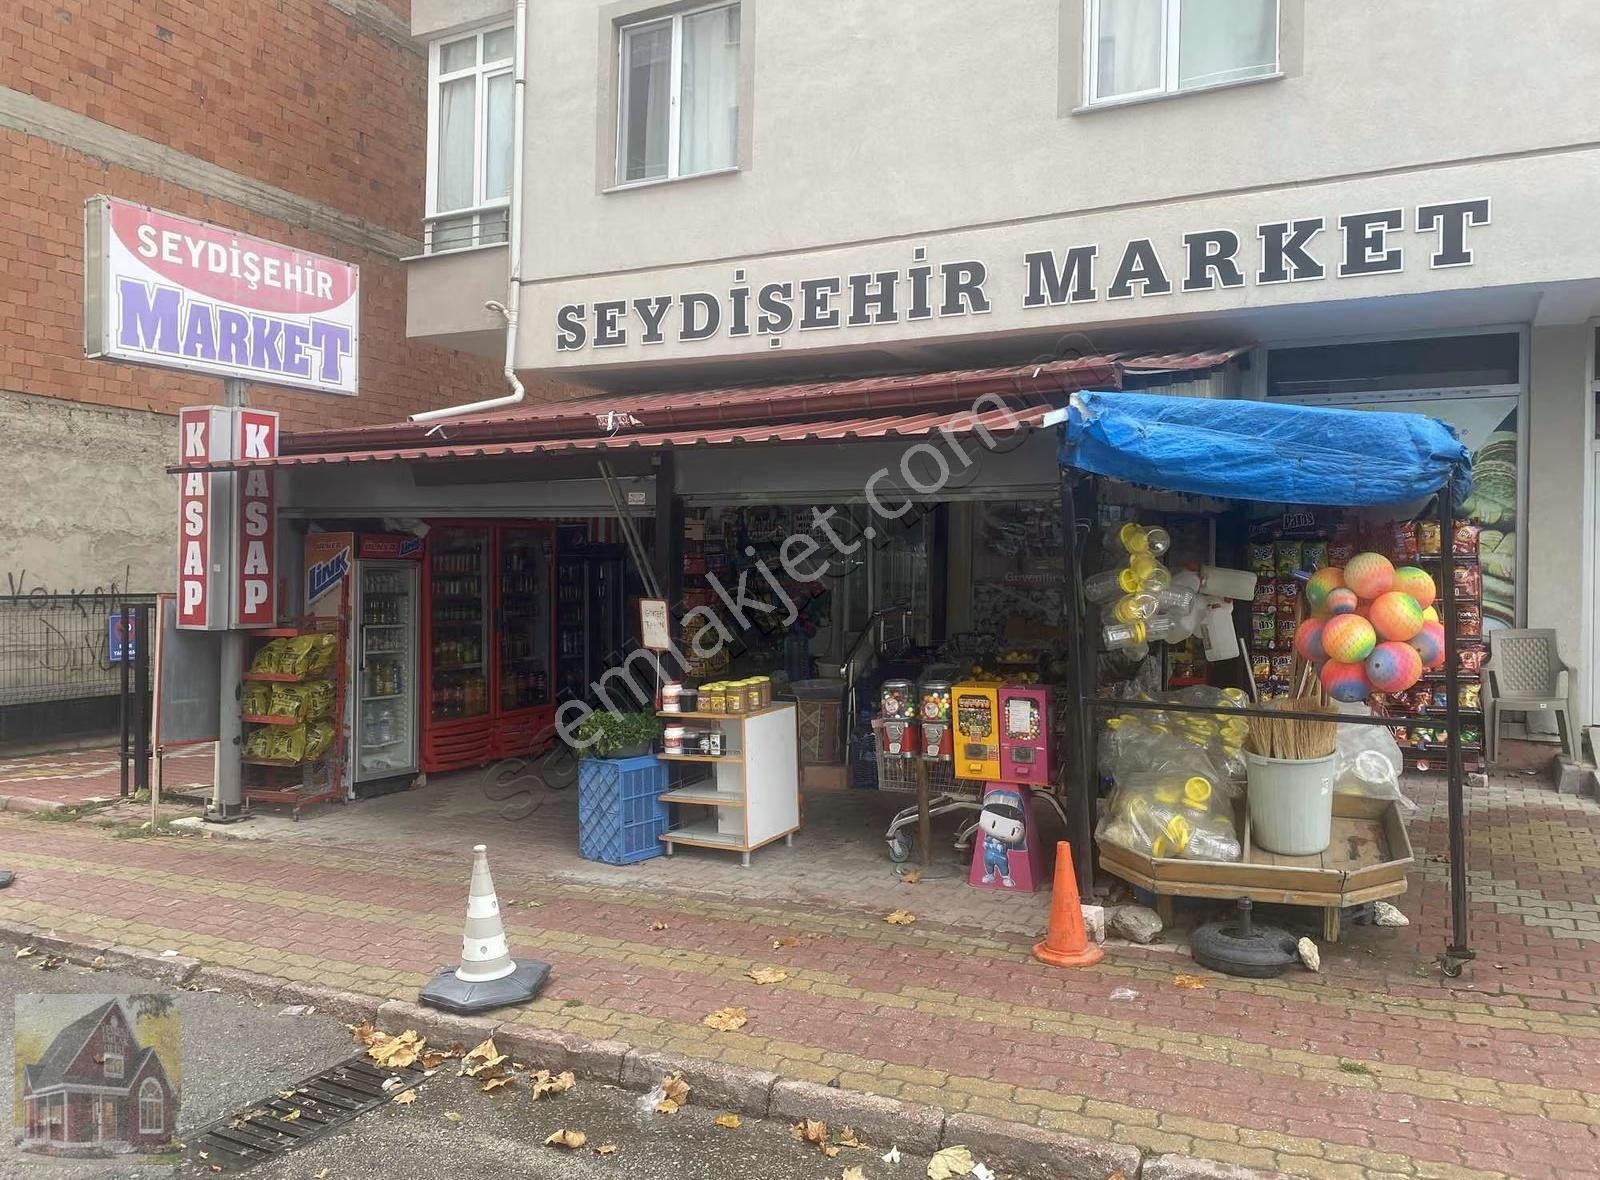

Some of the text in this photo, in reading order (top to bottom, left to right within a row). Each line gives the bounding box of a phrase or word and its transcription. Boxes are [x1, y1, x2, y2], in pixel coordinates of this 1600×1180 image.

[116, 276, 352, 384] MARKET
[136, 224, 333, 301] SEYDİŞEHİR
[555, 197, 1492, 352] SEYDİŞEHİR MARKET
[183, 421, 206, 616] KASAP
[243, 422, 271, 615] KASAP
